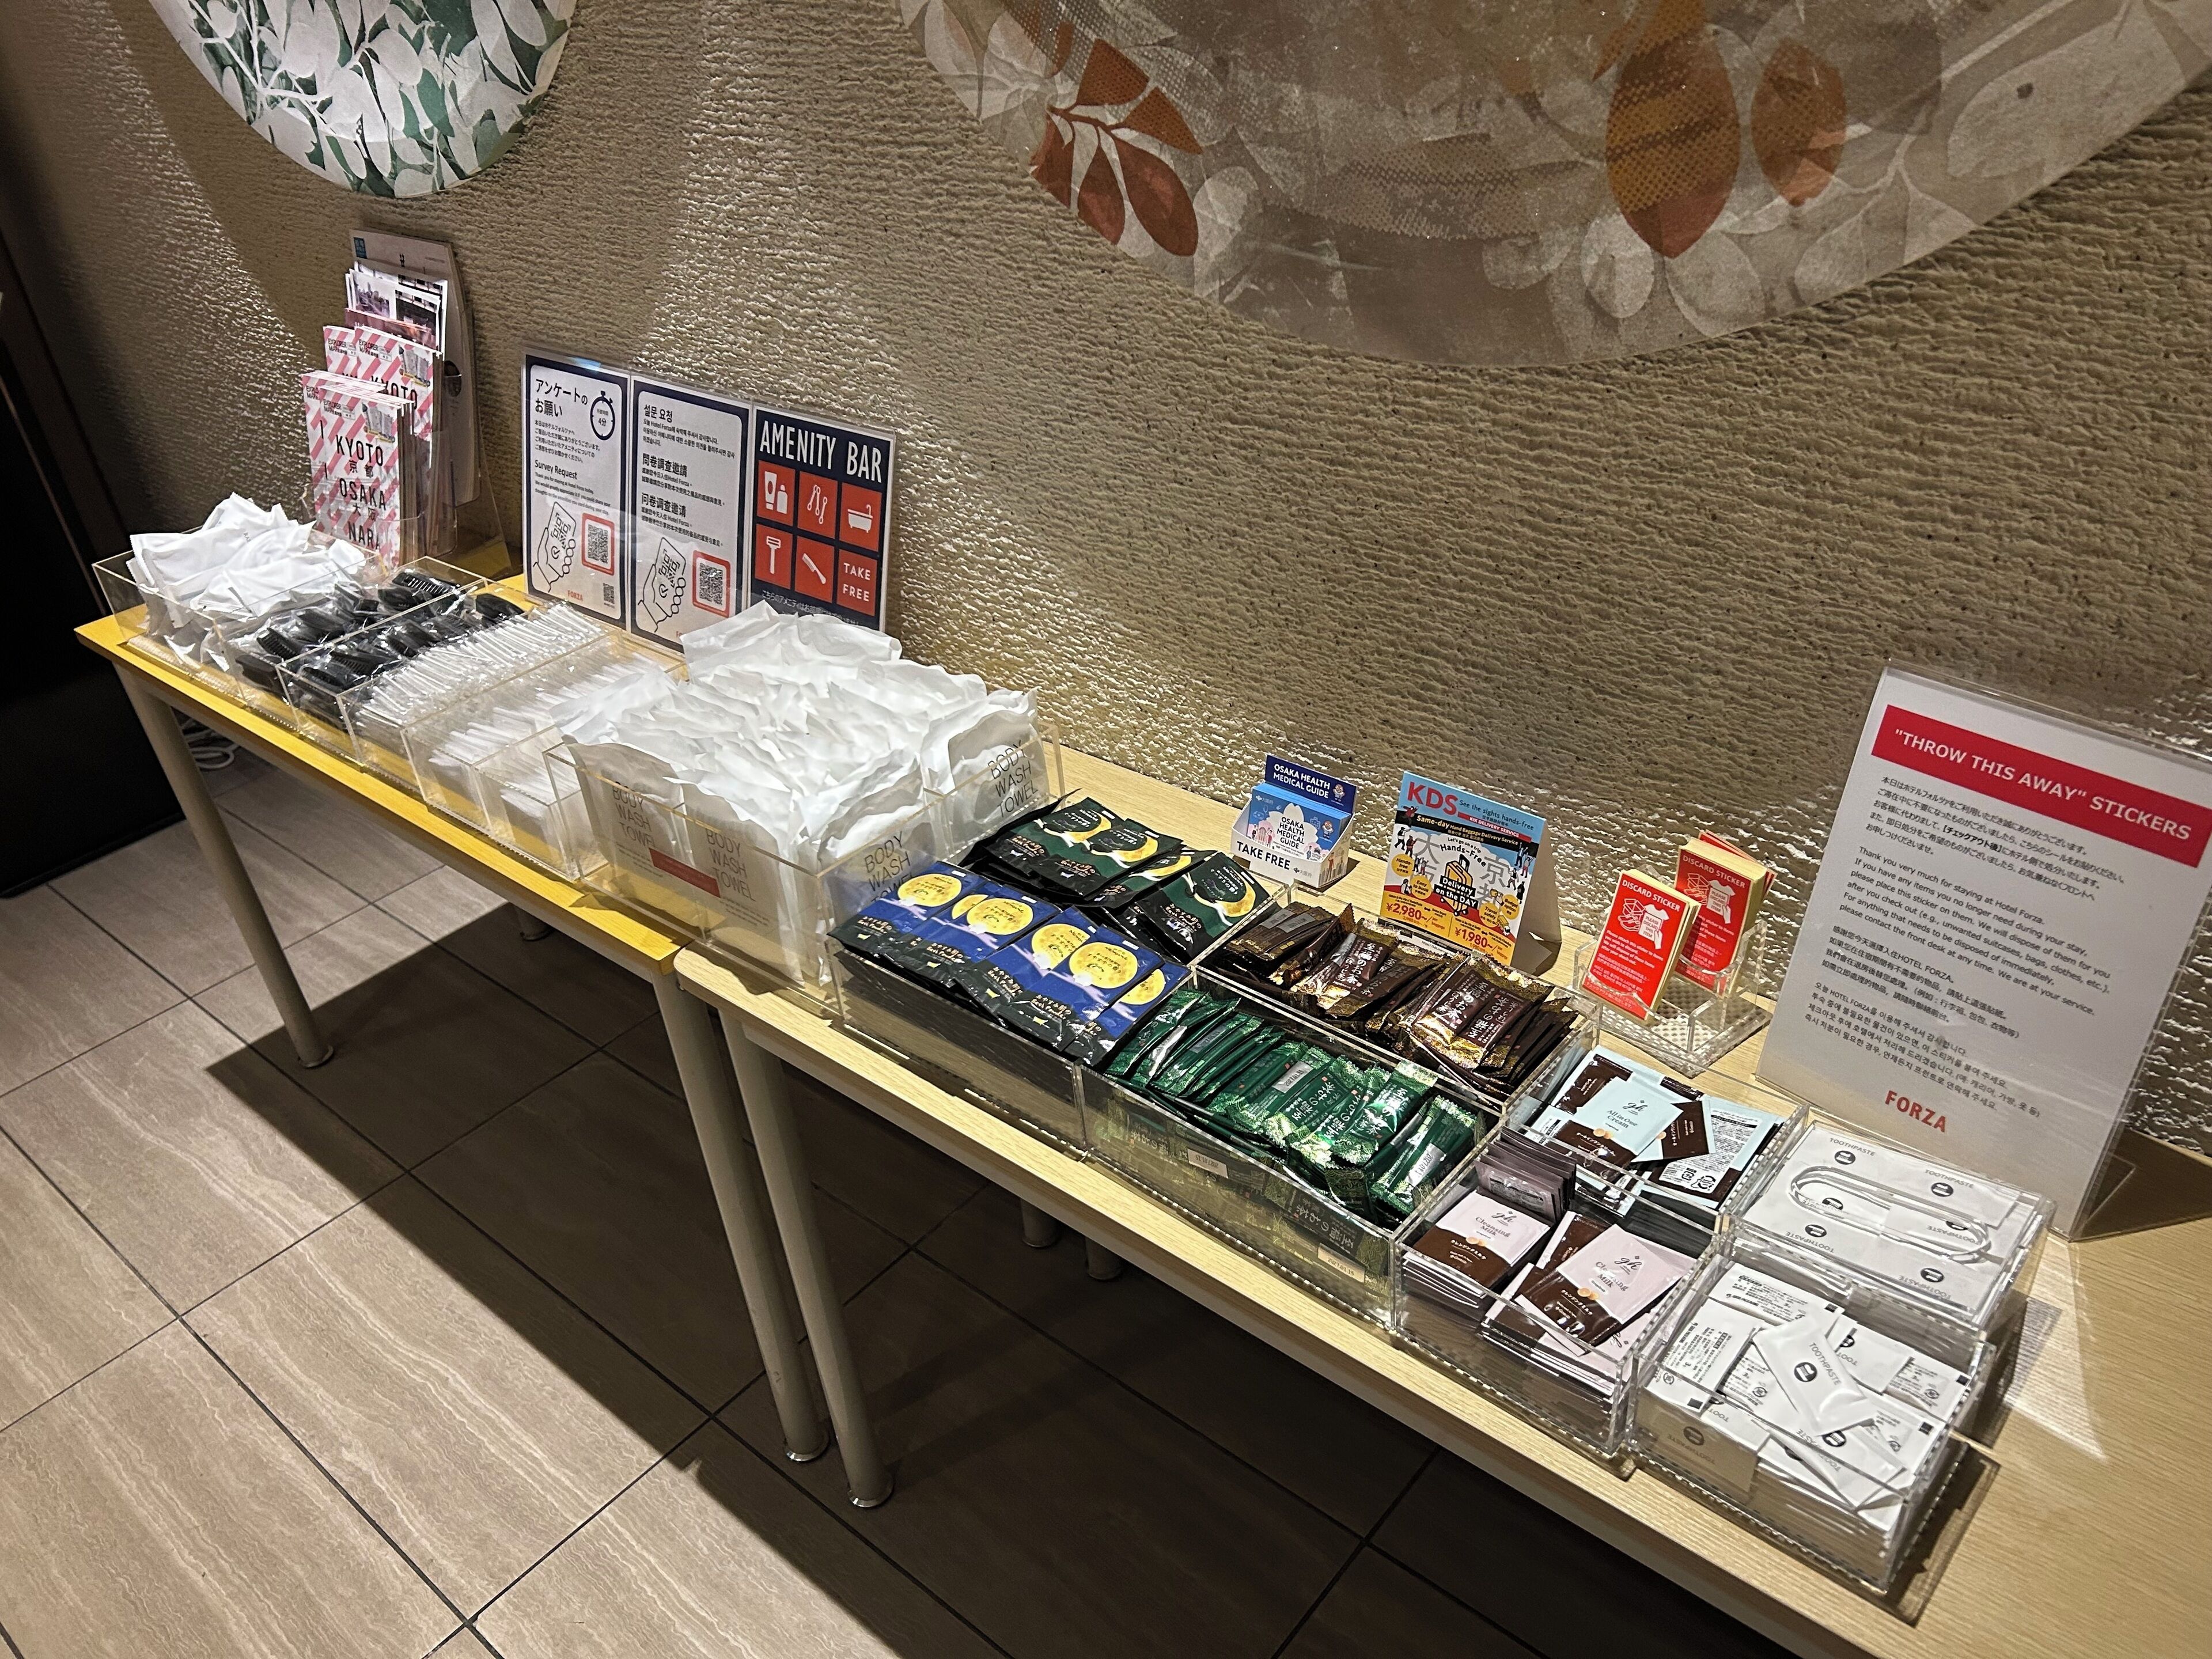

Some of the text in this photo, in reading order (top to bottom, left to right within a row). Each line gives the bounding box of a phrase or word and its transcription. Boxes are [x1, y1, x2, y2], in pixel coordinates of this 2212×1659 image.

[536, 378, 588, 406] アンケートの
[535, 398, 562, 417] お願い
[644, 404, 672, 423] 설문 요청
[336, 434, 383, 467] KYOTO
[759, 421, 882, 483] AMENITY BAR
[349, 460, 374, 478] 京都
[535, 459, 577, 480] Survey Request
[642, 453, 687, 478] 問卷調查邀請
[339, 478, 386, 510] OSAKA
[642, 492, 686, 518] 问卷调查邀请
[844, 562, 871, 581] TAKE
[843, 584, 870, 602] FREE
[988, 739, 1028, 779] BODY
[995, 760, 1032, 797] WASH
[1273, 772, 1329, 799] MEDICAL GUIDE
[1274, 763, 1331, 790] OSAKA HEALTH
[1895, 729, 2191, 839] "THROW THIS AWAY" STICKERS
[999, 780, 1039, 818] TOWEL
[1407, 781, 1458, 816] KDS
[615, 803, 652, 831] WASH
[1279, 823, 1305, 836] HEALTH
[1281, 816, 1304, 831] OSAKA
[1459, 800, 1534, 831] See the sights hands-free
[1478, 819, 1499, 830] DELIVERY
[1500, 827, 1519, 838] SERVICE
[706, 828, 741, 857] BODY
[1277, 828, 1304, 844] MEDICAL
[1280, 838, 1299, 849] GUIDE
[1416, 815, 1449, 830] Same-day
[1462, 827, 1481, 837] Baggage
[1481, 832, 1501, 842] Delivery
[1501, 837, 1518, 846] Service
[1865, 823, 1934, 855] お申しつけくださいませ。
[710, 847, 748, 878] WASH
[864, 831, 903, 873] BODY
[1237, 840, 1263, 859] TAKE
[1265, 852, 1290, 870] FREE
[1440, 843, 1486, 868] Hands-Free
[712, 868, 756, 902] TOWEL
[868, 851, 911, 892] WASH
[1682, 855, 1746, 888] DISCARD STICKER
[1859, 846, 1882, 861] Thank
[1883, 857, 1897, 867] you
[1899, 863, 1916, 875] very
[1916, 871, 1938, 883] much
[1940, 878, 1953, 888] for
[1953, 885, 1983, 902] staying
[1995, 900, 2018, 914] Hotel
[2018, 909, 2045, 925] Forza.
[1442, 877, 1474, 895] Delivery
[1445, 890, 1458, 901] the
[1459, 895, 1477, 908] DAY
[1622, 880, 1681, 912] DISCARD STICKER
[1862, 862, 1877, 872] you
[1877, 867, 1896, 880] have
[1897, 876, 1912, 887] any
[1913, 881, 1936, 895] items
[1936, 892, 1952, 902] you
[1953, 899, 1964, 907] no
[1965, 902, 1992, 917] longer
[1993, 914, 2015, 926] need
[2015, 923, 2043, 939] during
[2045, 934, 2065, 946] your
[2066, 944, 2088, 957] stay,
[1847, 882, 2109, 993] after you check out (e.g., unwanted suitcases, bags, clothes, etc.).
[1850, 870, 1874, 884] please
[1875, 881, 1896, 893] place
[1897, 888, 1911, 899] this
[1912, 896, 1939, 909] sticker
[1940, 907, 1950, 915] on
[1952, 910, 1975, 925] them.
[1978, 920, 1991, 931] We
[1993, 928, 2009, 938] will
[2009, 934, 2041, 951] dispose
[2054, 951, 2077, 965] them
[2078, 961, 2092, 971] for
[2093, 968, 2111, 979] you
[1839, 904, 1863, 918] please
[1864, 915, 1892, 930] contact
[1893, 926, 1906, 936] the
[1907, 931, 1926, 945] front
[1927, 941, 1946, 953] desk
[1957, 954, 1973, 965] any
[1974, 960, 1994, 974] time.
[1998, 969, 2012, 980] We
[2013, 978, 2028, 987] are
[2029, 984, 2039, 992] at
[2040, 988, 2061, 1000] your
[2061, 998, 2094, 1015] service.
[1291, 1081, 1337, 1120] 至福のお茶
[1885, 1090, 1946, 1132] FORZA
[1607, 1109, 1617, 1118] All
[1624, 1117, 1638, 1127] One
[1607, 1114, 1629, 1128] Cream
[1829, 1137, 1877, 1157] TOOTHPASTE
[1925, 1169, 1975, 1189] TOOTHPASTE
[1475, 1217, 1511, 1238] Cleansing
[1480, 1225, 1497, 1236] Milk
[1785, 1230, 1835, 1253] TOOTHPASTE
[1327, 1257, 1355, 1277] 2027.01.15
[1597, 1273, 1613, 1289] Milk
[1898, 1275, 1953, 1300] TOOTHPASTE
[1809, 1342, 1842, 1385] TOOTHPASTE
